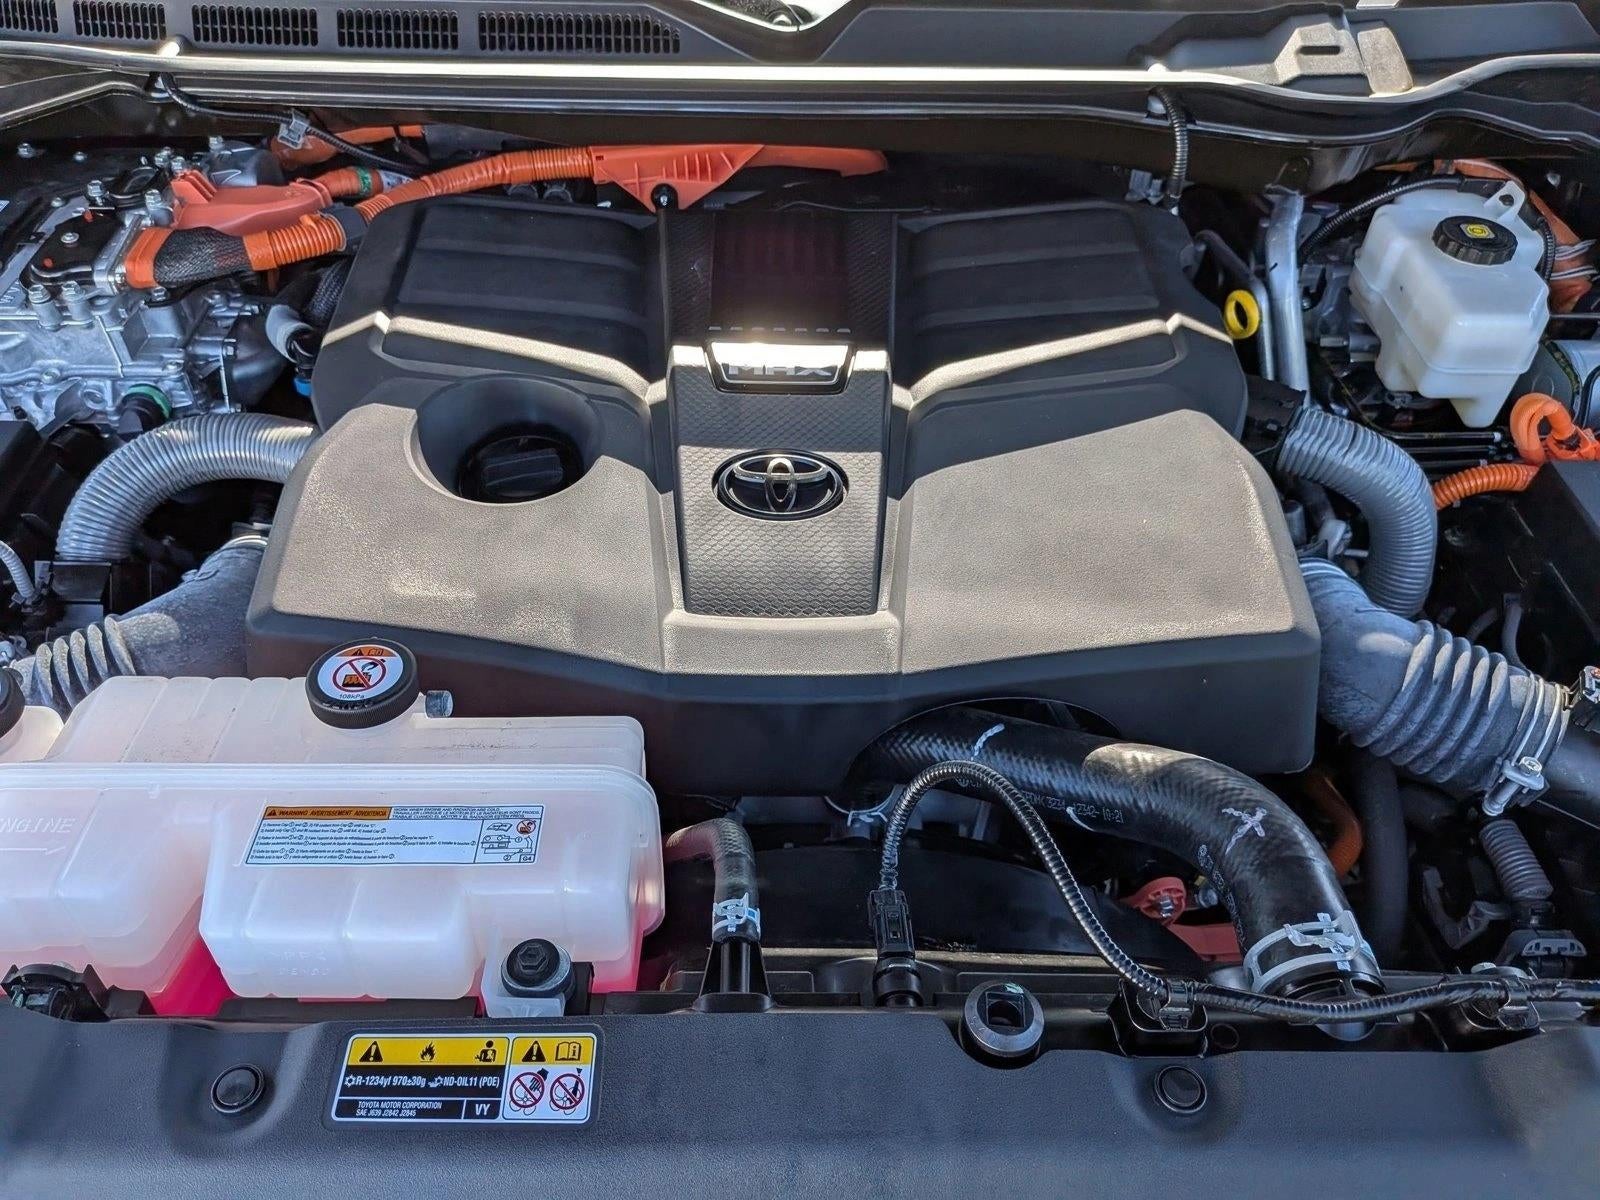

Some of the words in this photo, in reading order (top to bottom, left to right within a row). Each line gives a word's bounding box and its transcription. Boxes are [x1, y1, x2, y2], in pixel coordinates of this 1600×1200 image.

[0, 818, 75, 832] NGINE
[356, 1075, 391, 1088] R-1234yf
[392, 1075, 427, 1088] 970±30g
[443, 1076, 478, 1087] ND-OIL11
[479, 1076, 500, 1088] (POE)
[358, 1101, 380, 1109] TOYOTA
[380, 1101, 401, 1109] MOTOR
[401, 1101, 443, 1109] CORPORATION
[475, 1103, 491, 1116] VY
[355, 1109, 367, 1117] SAE
[367, 1109, 381, 1117] J639
[381, 1109, 399, 1117] J2842
[399, 1109, 417, 1117] J2845
